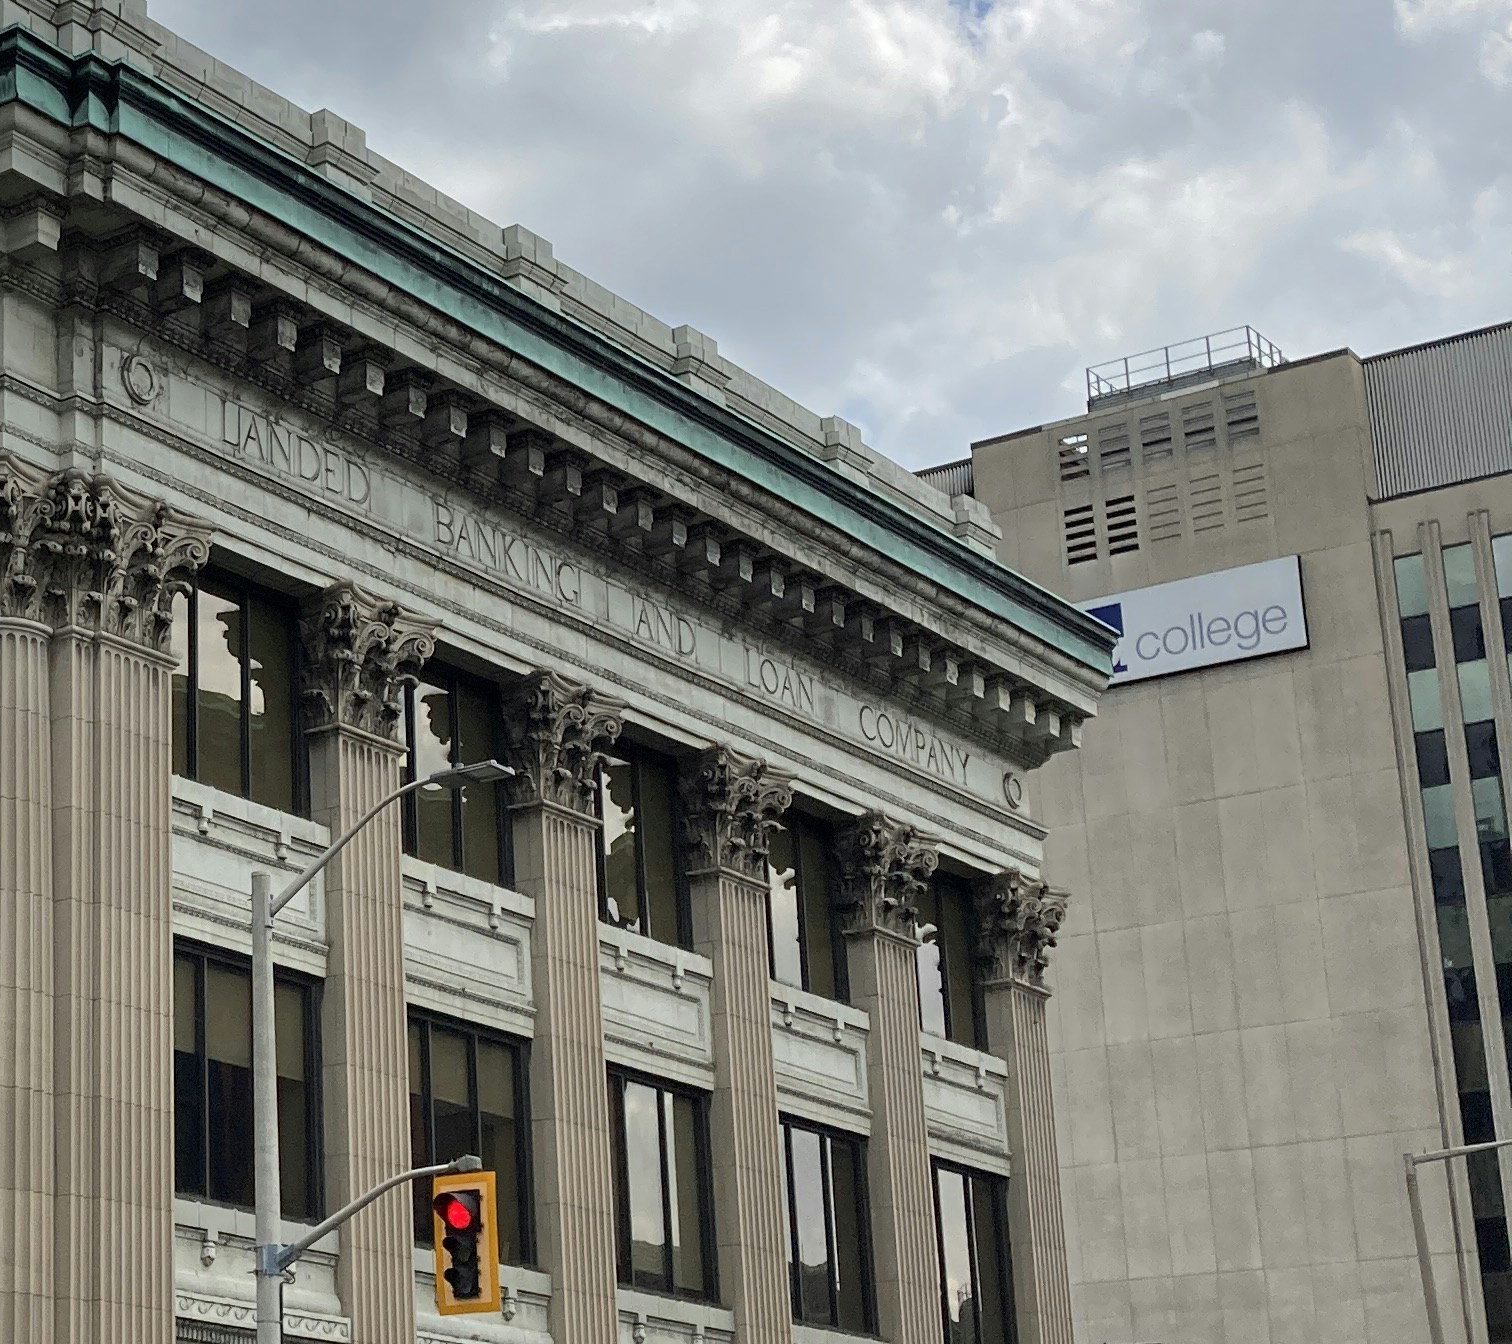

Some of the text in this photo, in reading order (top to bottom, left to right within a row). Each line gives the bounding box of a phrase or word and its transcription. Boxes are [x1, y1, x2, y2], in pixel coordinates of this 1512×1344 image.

[221, 398, 972, 787] LANDED BANKING AND LOAN COMPANY
[1135, 604, 1288, 660] college
